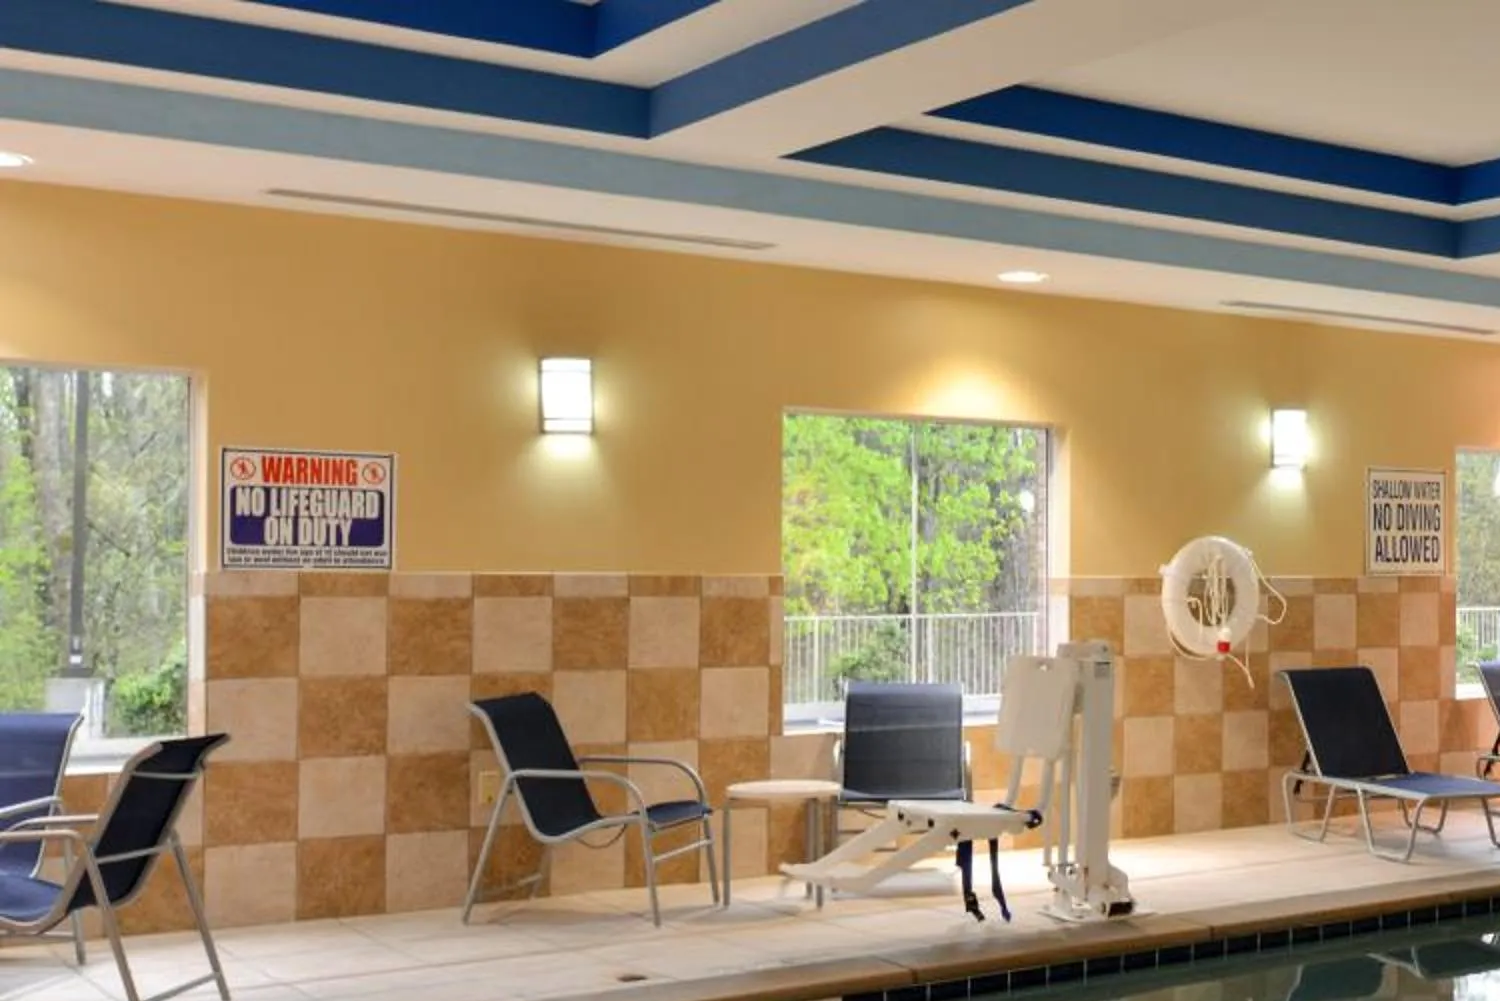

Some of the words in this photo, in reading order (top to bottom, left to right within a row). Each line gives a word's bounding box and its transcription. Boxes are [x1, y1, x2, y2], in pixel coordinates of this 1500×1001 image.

[261, 455, 358, 485] WARNING
[235, 487, 265, 517] NO
[270, 488, 380, 519] LIFEGUARD
[1373, 480, 1411, 500] SHALLOW
[1413, 481, 1440, 500] WATER
[264, 516, 293, 545] ON
[300, 517, 353, 545] DUTY
[1373, 503, 1392, 531] NO
[1397, 503, 1440, 531] DIVING
[1375, 535, 1440, 562] ALLOWED
